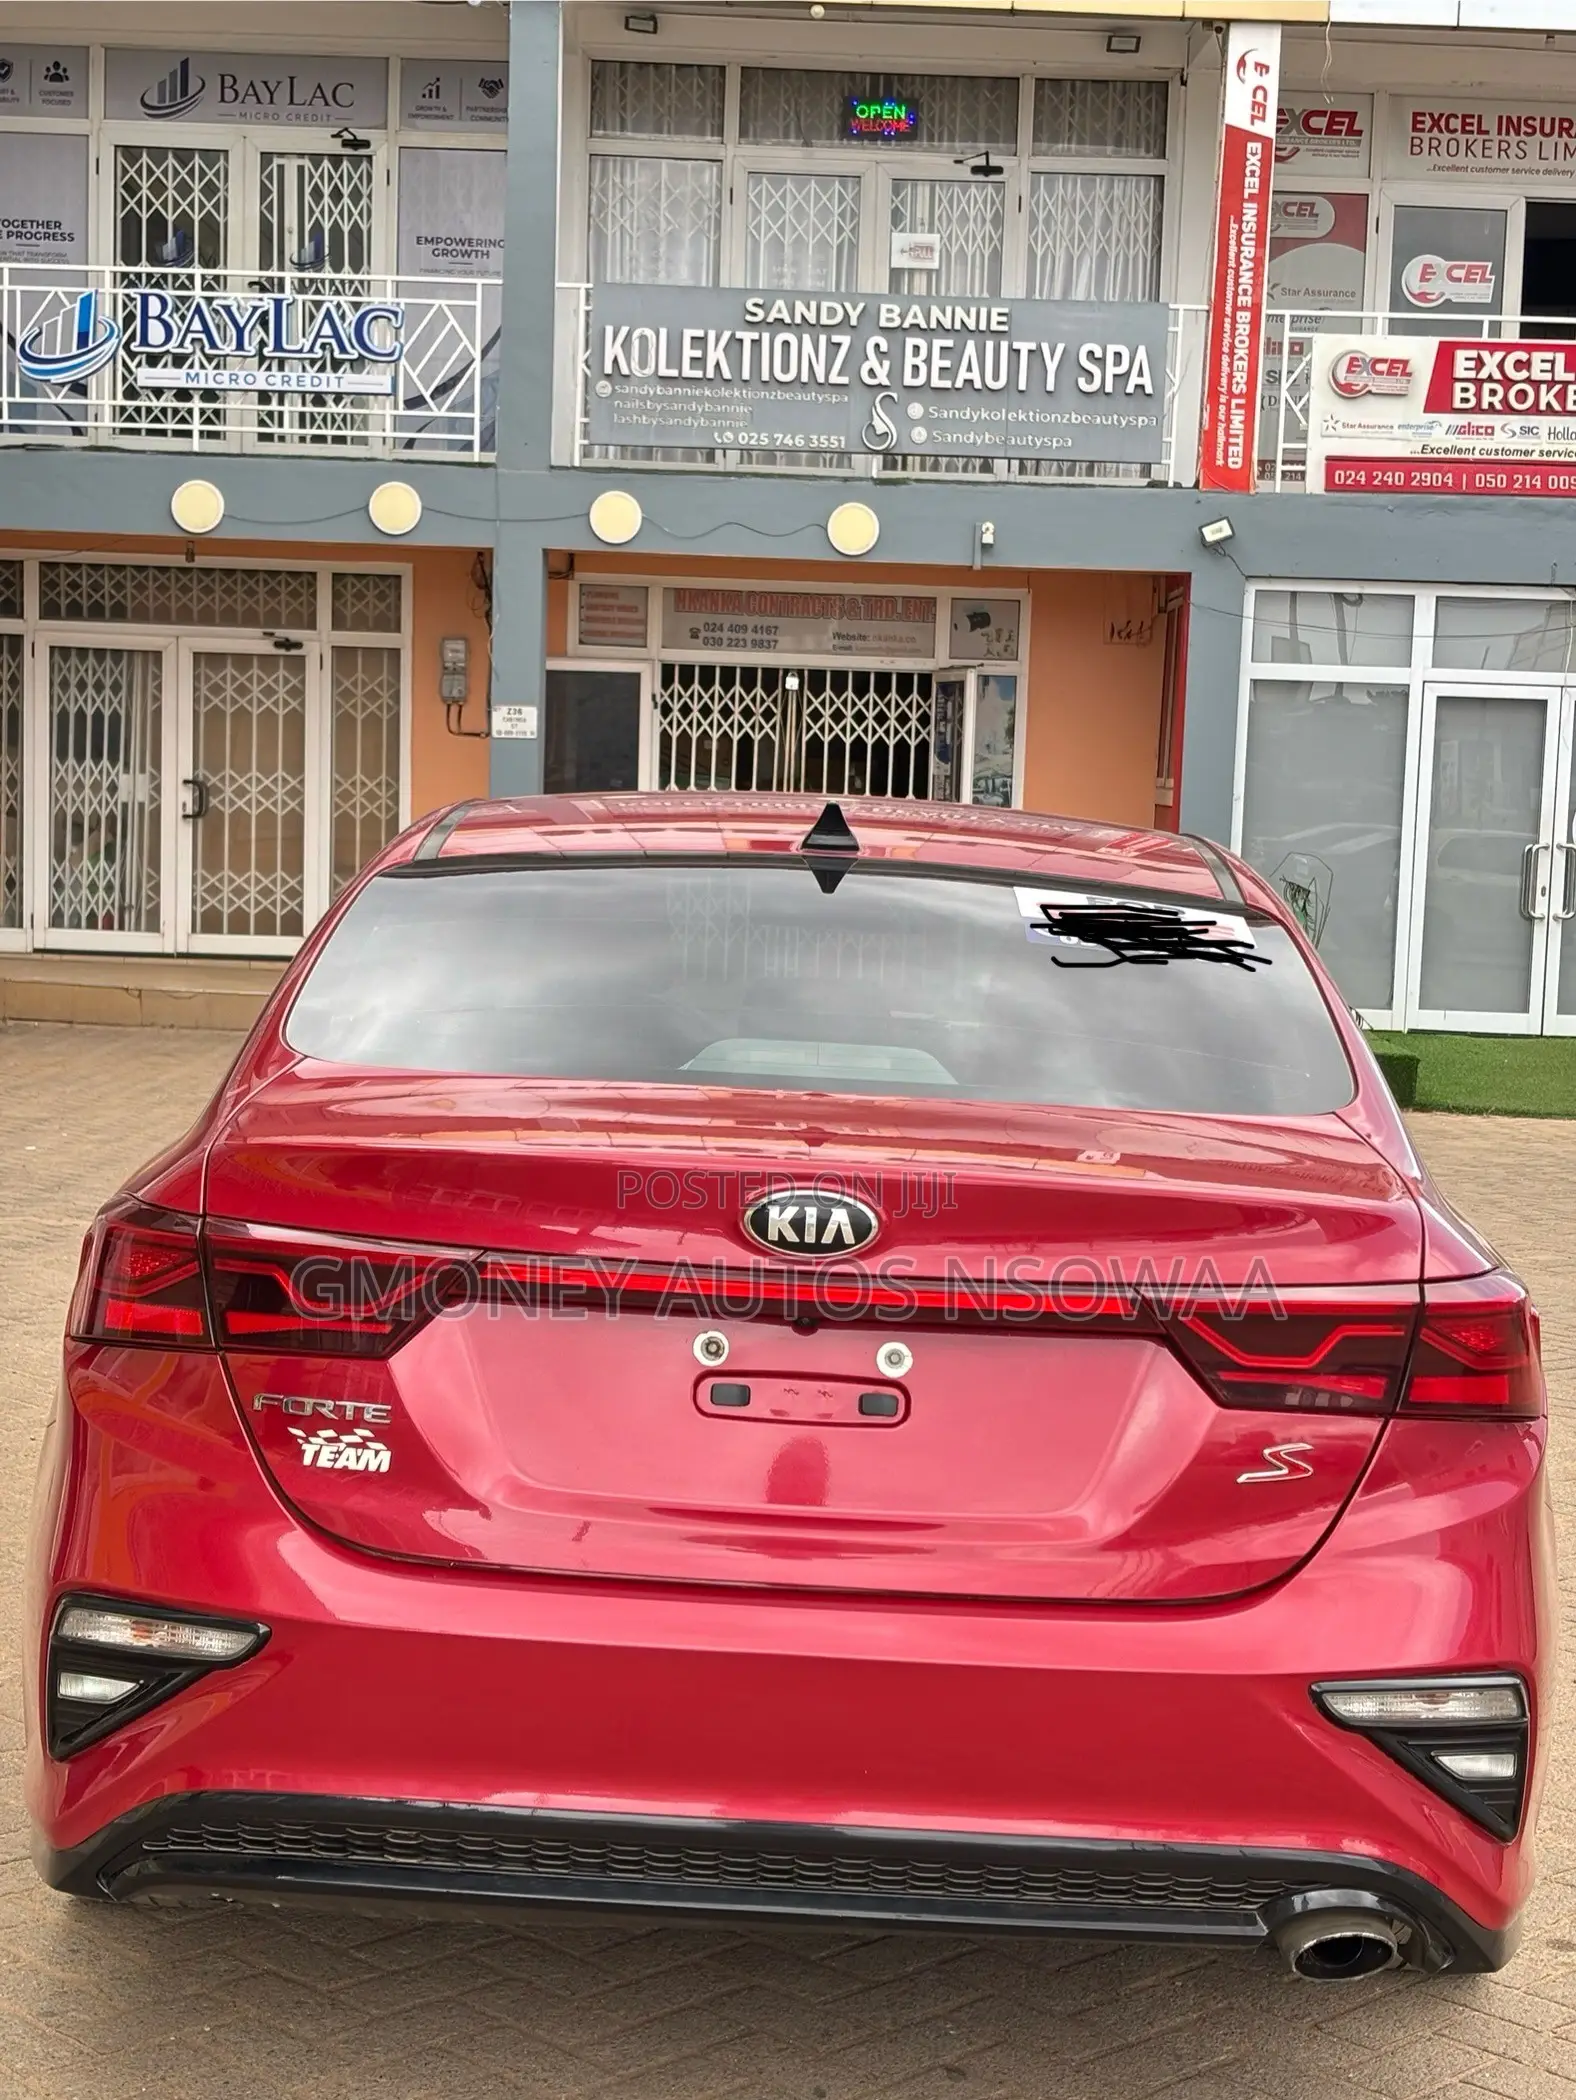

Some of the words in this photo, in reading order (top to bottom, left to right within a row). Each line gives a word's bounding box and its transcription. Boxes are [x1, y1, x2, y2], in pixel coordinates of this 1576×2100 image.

[239, 112, 280, 121] MICRO
[286, 112, 331, 123] CREDIT
[856, 104, 907, 120] OPEN
[1411, 111, 1490, 136] EXCEL
[1410, 136, 1528, 161] BROKERS
[1244, 141, 1262, 199] EXCEL
[1470, 166, 1509, 175] customer
[1511, 167, 1540, 175] service
[1542, 169, 1575, 179] delivery
[0, 218, 62, 230] OGETHER
[6, 230, 75, 242] PROGRESS
[431, 248, 490, 259] GROWTH
[1237, 202, 1258, 307] INSURANCE
[1224, 268, 1236, 316] customer
[1280, 287, 1301, 297] Star
[1303, 288, 1357, 298] Assurance
[743, 297, 866, 328] SANDY
[878, 303, 1010, 332] BANNIE
[1222, 317, 1233, 353] service
[602, 324, 852, 386] KOLEKTIONZ
[859, 335, 892, 387] &
[902, 336, 1066, 393] BEAUTY
[1076, 342, 1155, 396] SPA
[1232, 310, 1251, 394] BROKERS
[1218, 354, 1232, 394] delivery
[1346, 356, 1413, 377] EXCEL
[1453, 349, 1576, 381] EXCEL
[184, 371, 258, 386] MICRO
[264, 374, 345, 389] CREDIT
[614, 383, 849, 404] sandybanniekolektionzbeautyspa
[614, 400, 752, 414] nailsbysandybannie
[928, 405, 1158, 428] Sandykolektionzbeautyspa
[1217, 404, 1226, 422] our
[613, 413, 748, 429] lashbysandybannie
[1342, 422, 1356, 430] Star
[1398, 423, 1434, 432] enterprise
[1519, 426, 1540, 436] SIC
[737, 432, 769, 446] 025
[774, 434, 805, 448] 746
[808, 434, 846, 449] 3551
[932, 429, 1073, 449] Sandybeautyspa
[1227, 398, 1246, 469] LIMITED
[1215, 422, 1228, 467] hallmark
[1478, 447, 1535, 457] customer
[1538, 449, 1576, 459] servic
[1335, 470, 1366, 486] 024
[1372, 472, 1404, 486] 240
[1410, 472, 1453, 488] 2904
[1475, 474, 1507, 489] 050
[1512, 475, 1541, 490] 214
[744, 590, 844, 620] CONTRACTS
[843, 594, 863, 621] &
[703, 622, 724, 633] 024
[727, 623, 748, 635] 409
[751, 625, 780, 636] 4167
[832, 632, 870, 642] Website:
[702, 637, 723, 648] 030
[726, 638, 747, 649] 223
[750, 639, 779, 651] 9837
[507, 707, 523, 716] Z36
[767, 1205, 856, 1244] KIA
[252, 1393, 392, 1424] FORTE
[301, 1443, 392, 1473] TEAM
[1236, 1442, 1314, 1484] S
